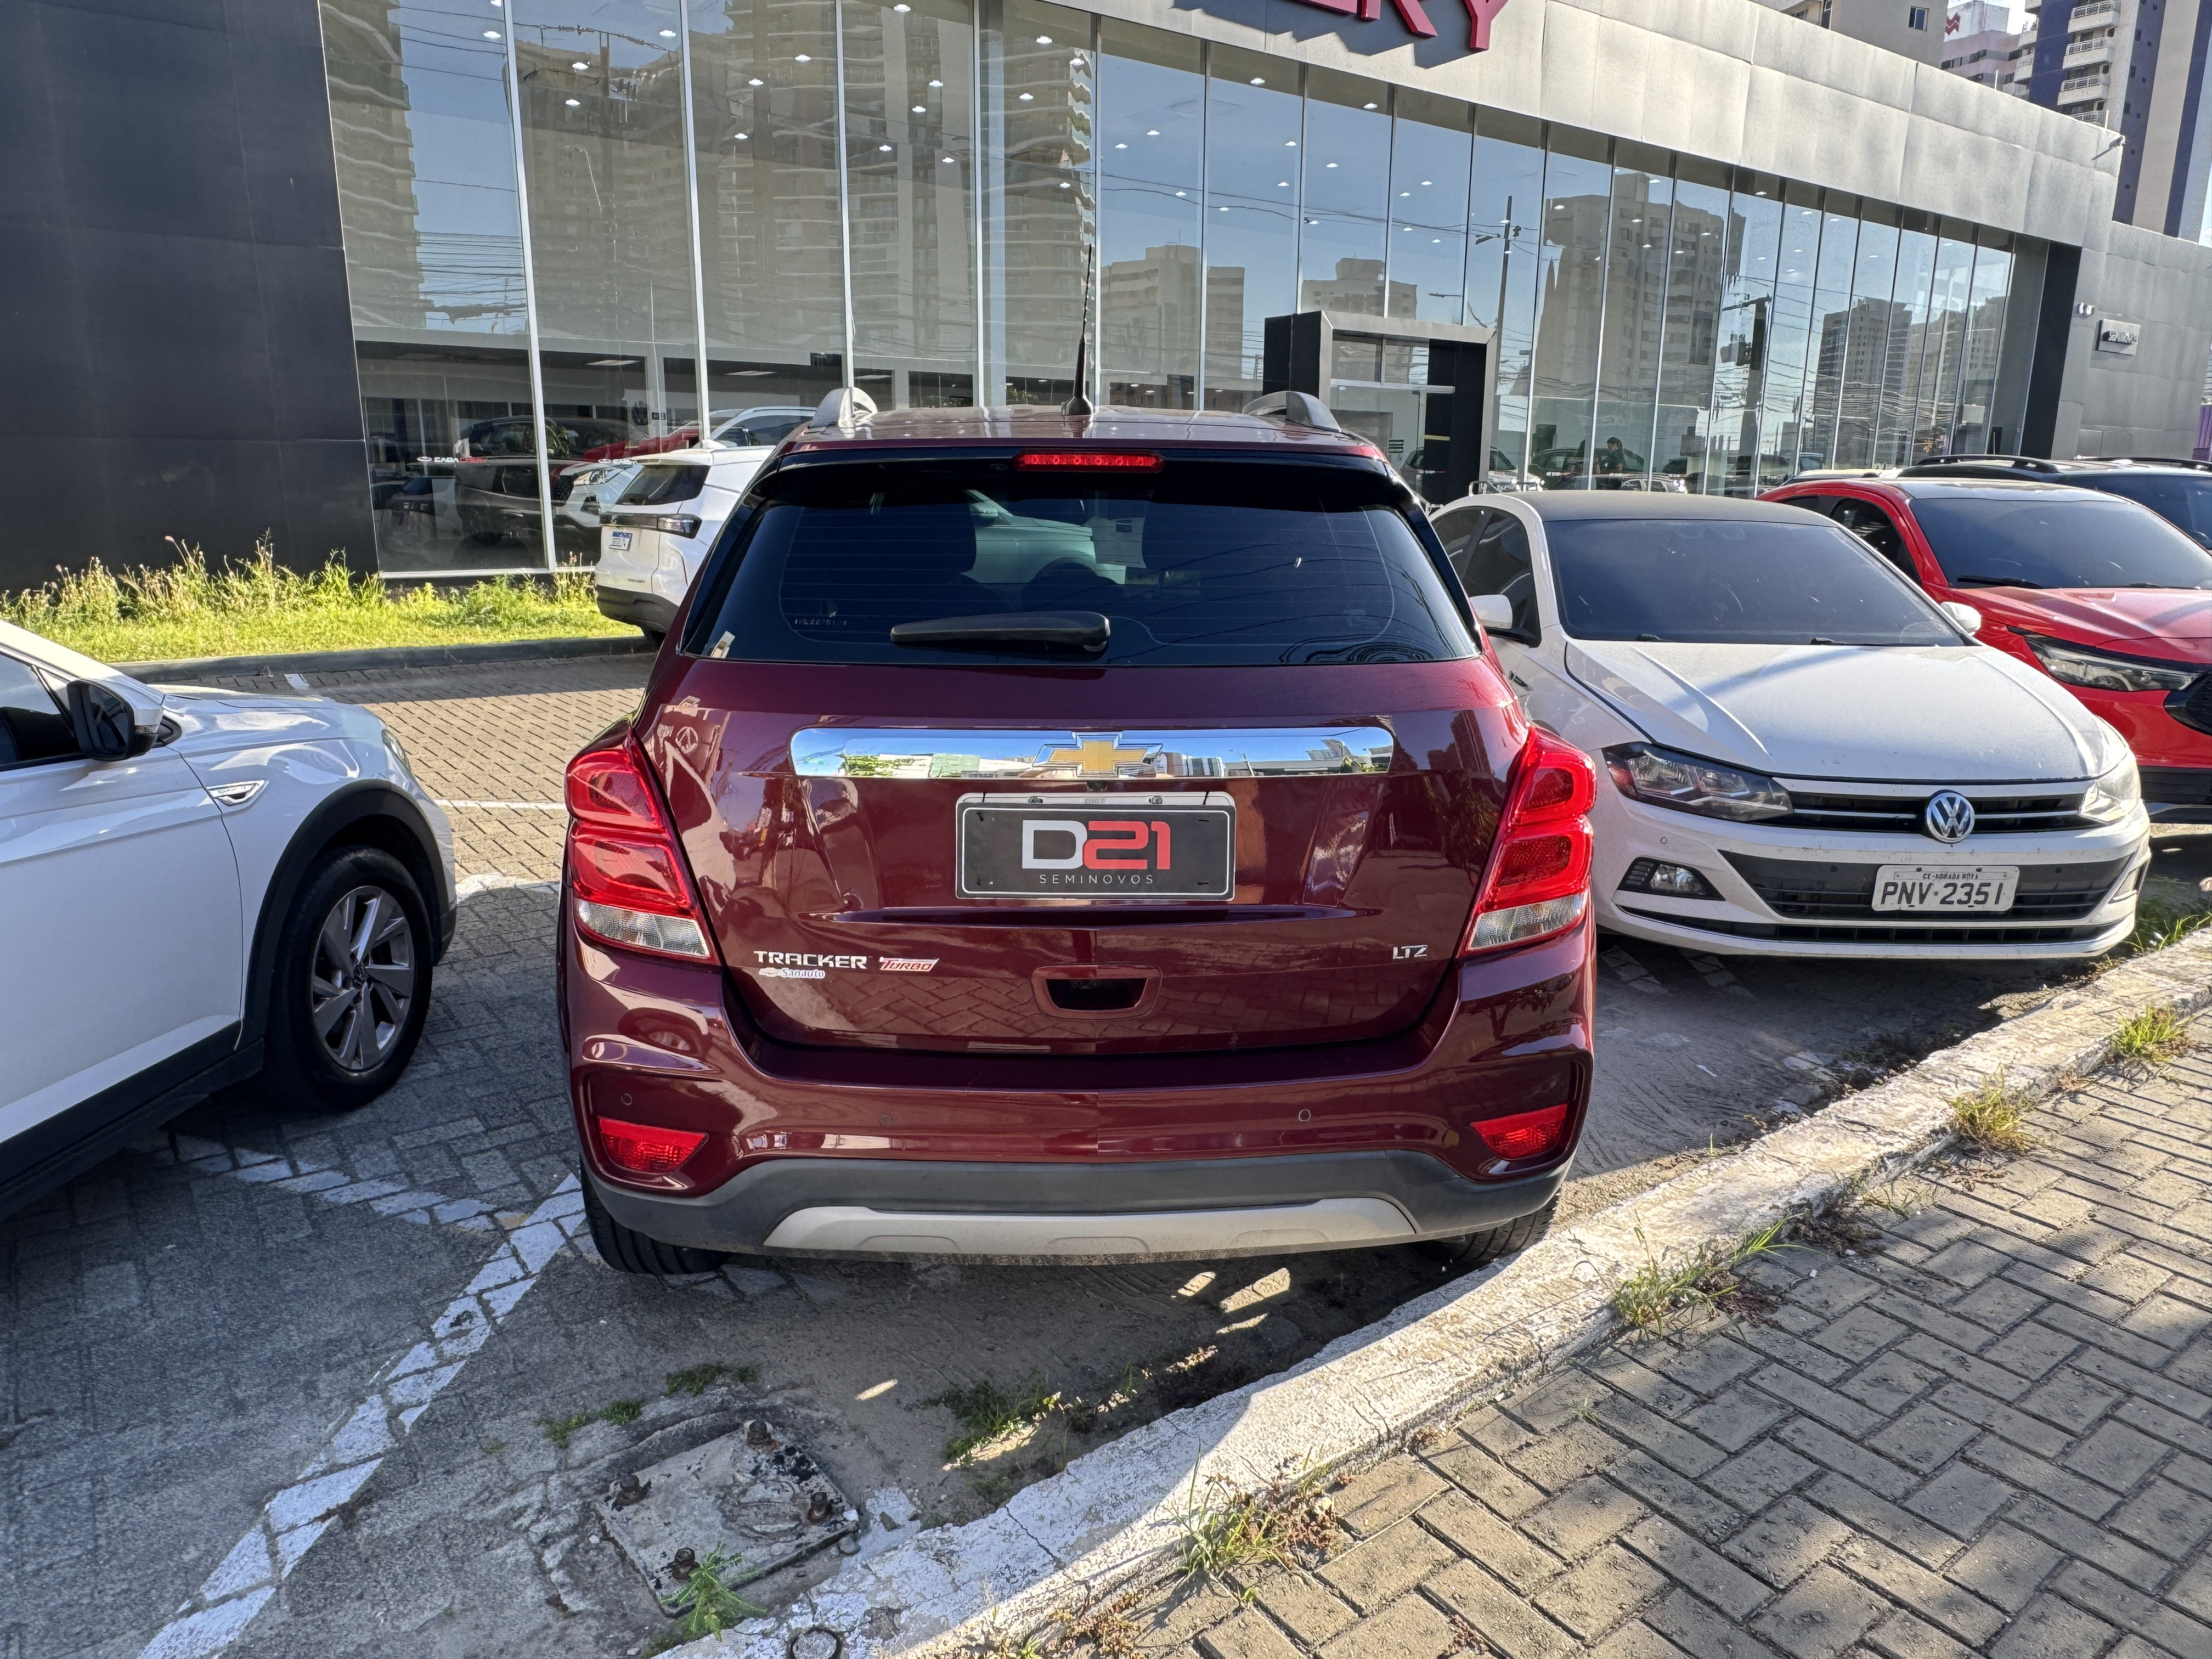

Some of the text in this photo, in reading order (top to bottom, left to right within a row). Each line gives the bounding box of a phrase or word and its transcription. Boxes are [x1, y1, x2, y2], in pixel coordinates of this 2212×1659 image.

[1022, 820, 1171, 870] D21
[1039, 874, 1153, 884] SEMINOVOS
[753, 950, 868, 969] TRACKER
[1392, 944, 1428, 960] LTZ
